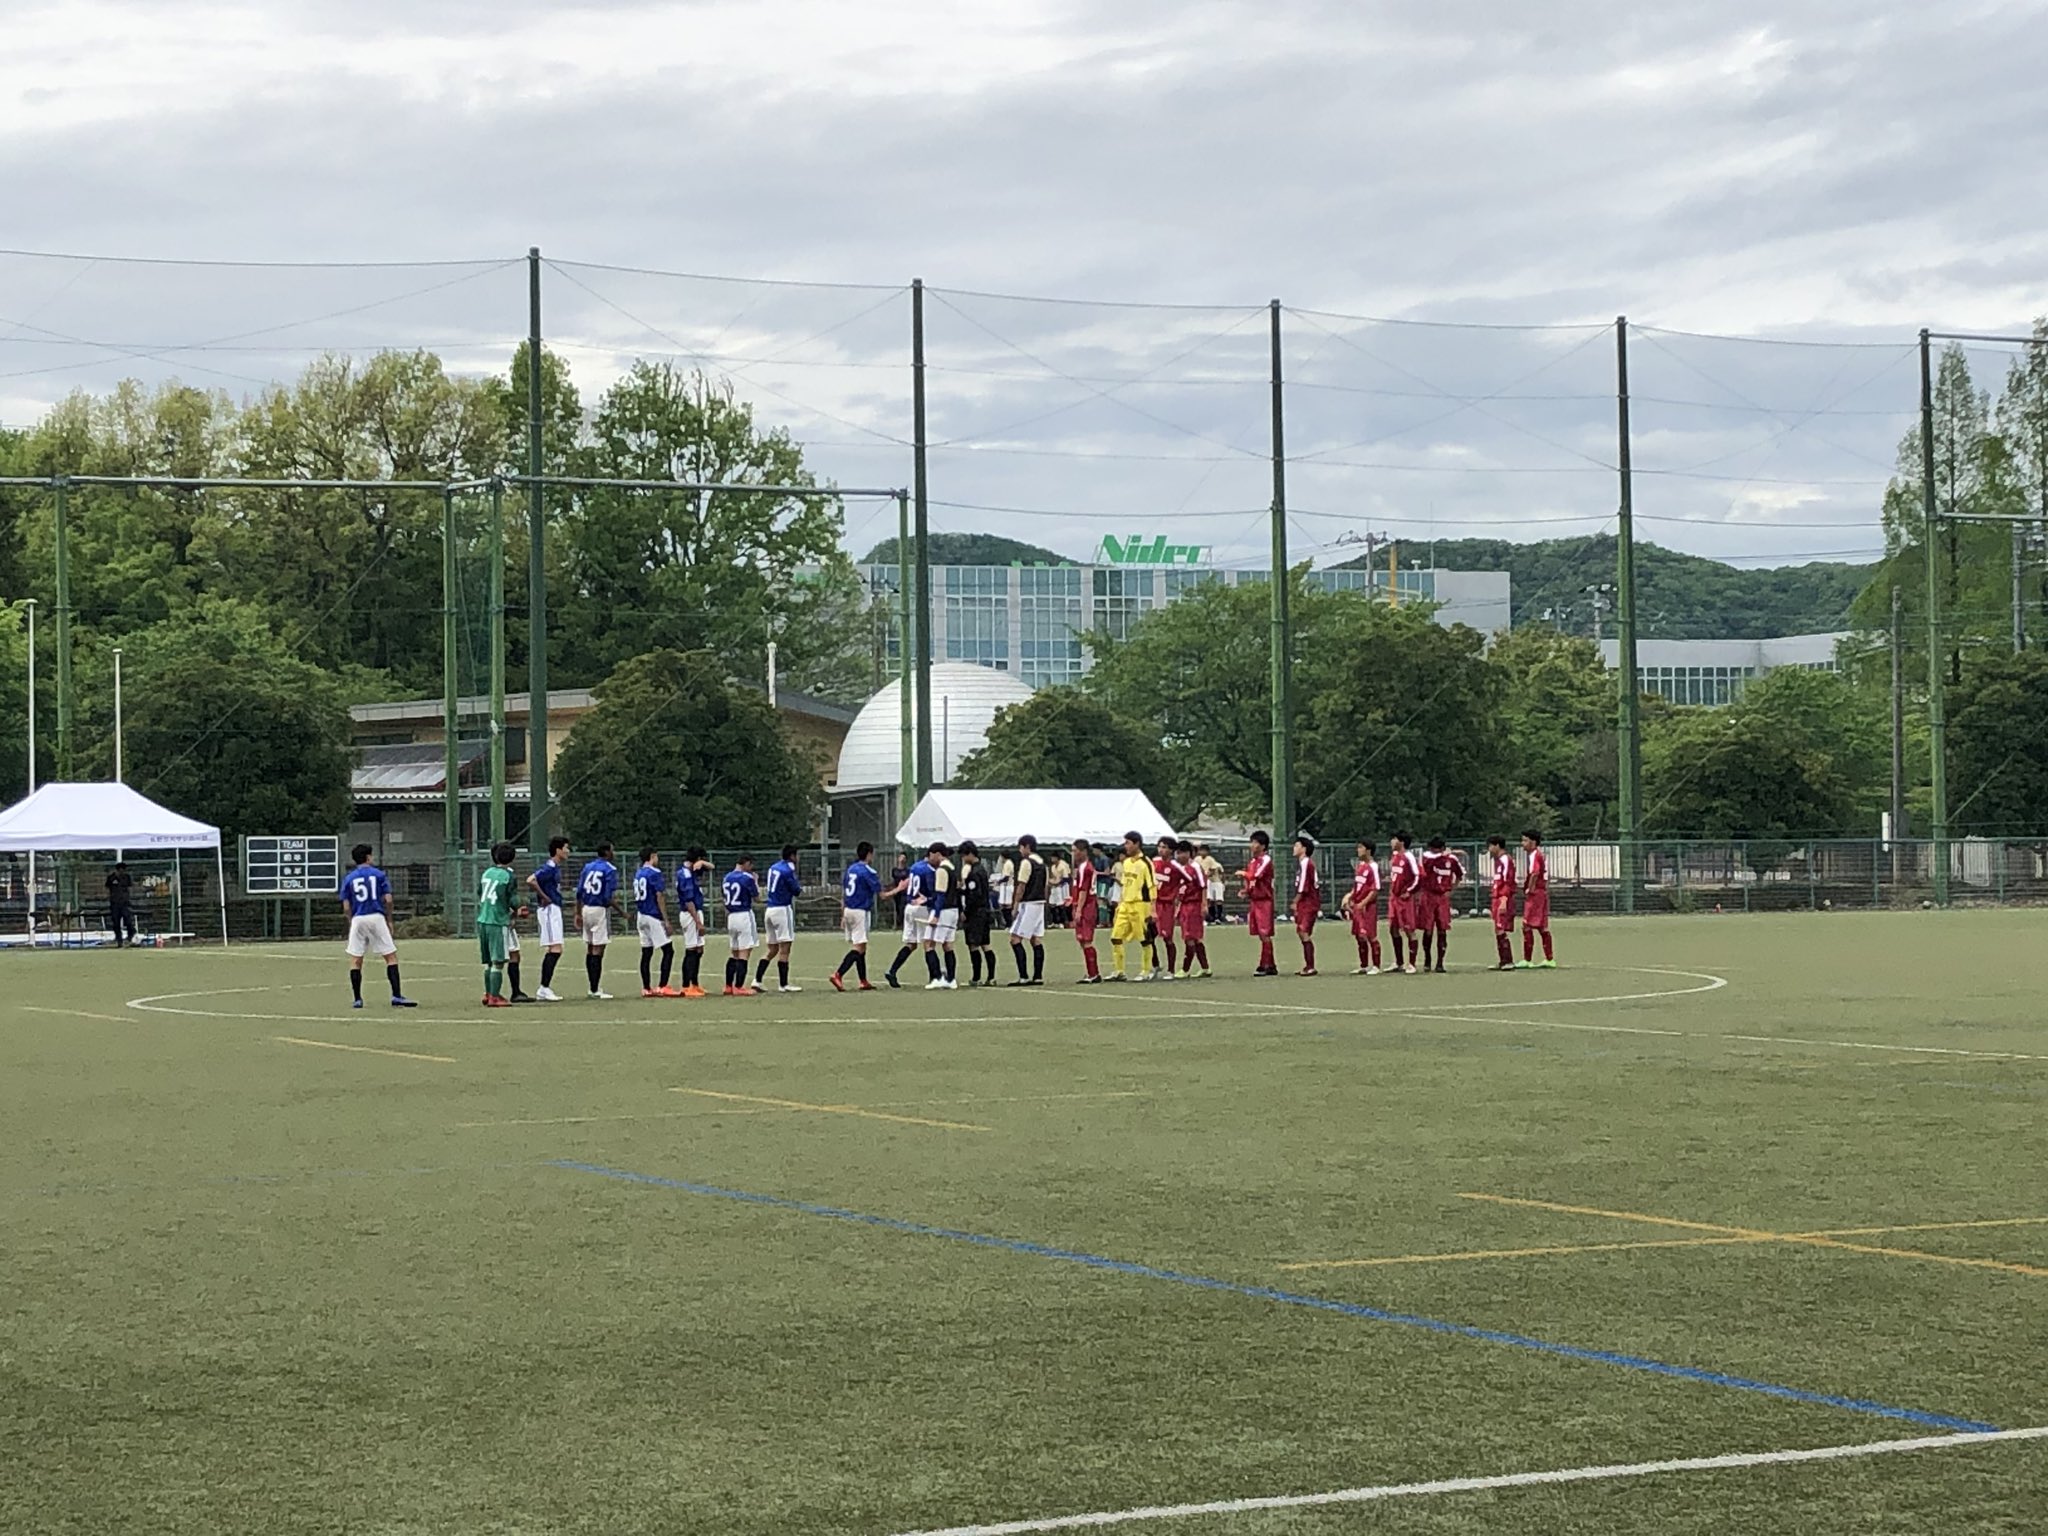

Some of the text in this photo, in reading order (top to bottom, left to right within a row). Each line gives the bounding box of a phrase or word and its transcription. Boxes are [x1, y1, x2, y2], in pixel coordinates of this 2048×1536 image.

[352, 875, 378, 902] 51
[481, 878, 498, 905] 74
[583, 870, 604, 895] 45
[767, 868, 781, 893] 17
[845, 873, 858, 897] 3
[722, 882, 742, 905] 52
